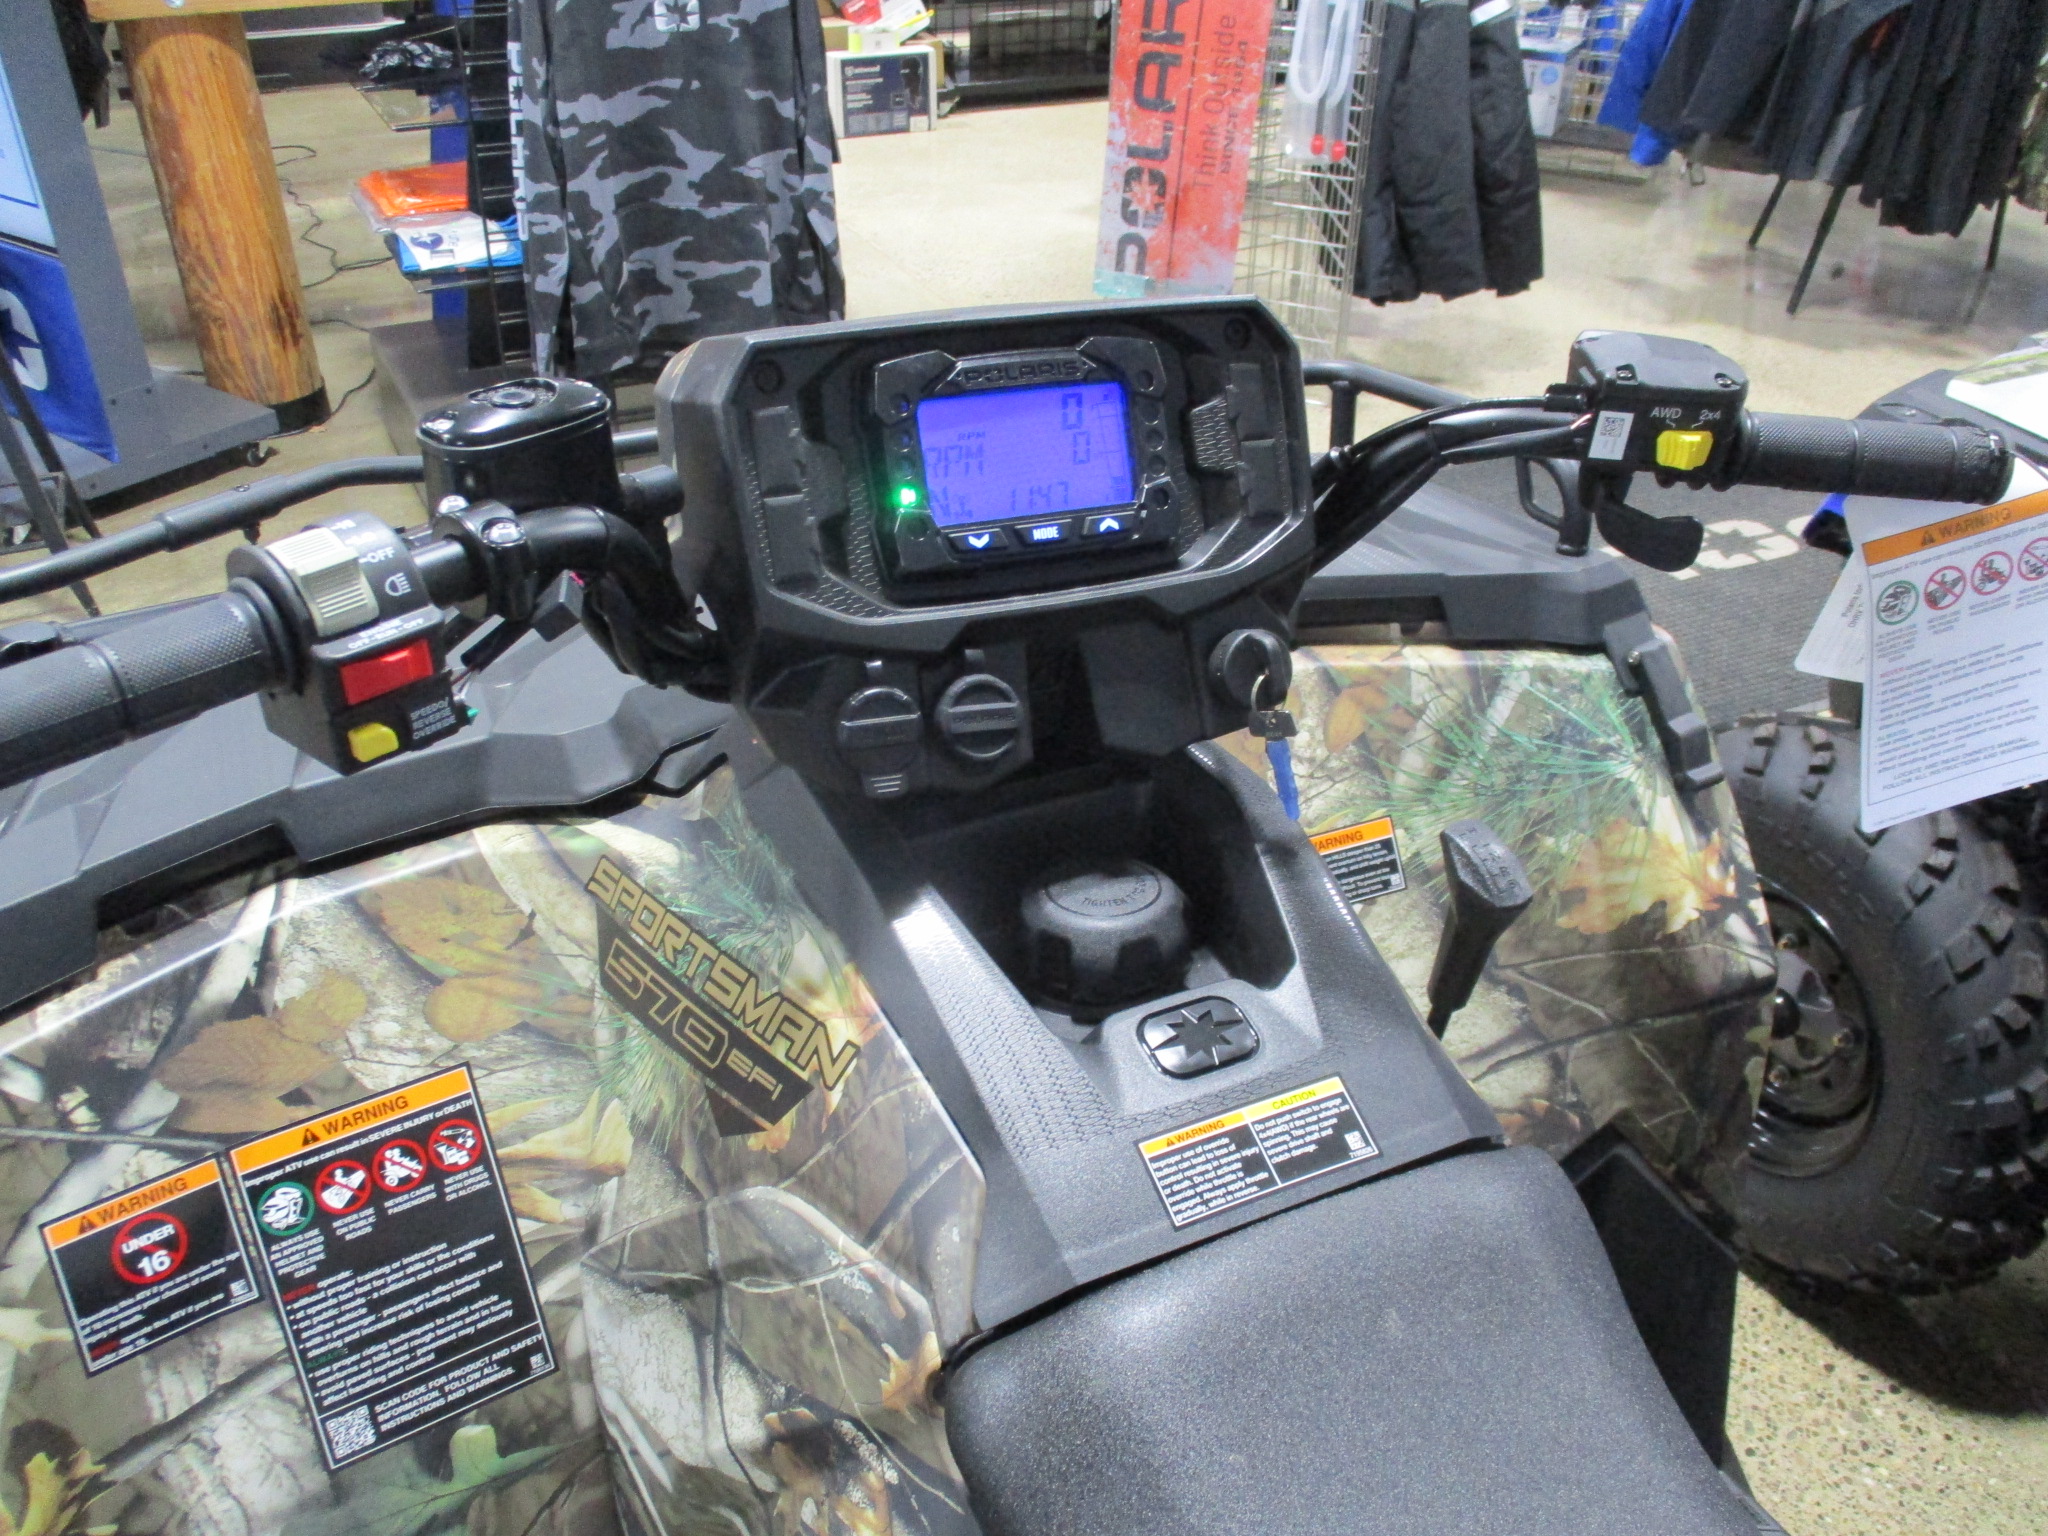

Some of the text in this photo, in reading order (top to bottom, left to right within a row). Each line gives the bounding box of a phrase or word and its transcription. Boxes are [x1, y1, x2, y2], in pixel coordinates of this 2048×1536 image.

[1193, 14, 1236, 188] Think Outside
[963, 361, 1081, 382] POLARIS
[1062, 393, 1082, 430] 0
[1650, 407, 1720, 420] AWD 2x4
[958, 432, 985, 441] RPM
[1073, 431, 1090, 464] 0
[1033, 526, 1059, 540] MODE
[1939, 508, 2011, 538] WARNING
[413, 708, 452, 730] REVERSE
[413, 716, 456, 740] OVERRIDE
[585, 855, 860, 1090] SPORTSMAN
[604, 938, 783, 1100] 570 EFI
[1271, 1088, 1316, 1109] CAUTION
[322, 1093, 409, 1136] WARNING
[284, 1160, 302, 1172] ATV
[367, 1123, 402, 1141] SEVERE
[402, 1112, 433, 1128] INJURY
[442, 1098, 473, 1114] DEATH
[1174, 1119, 1225, 1142] WARNING
[444, 1165, 483, 1184] NEVER USE
[444, 1172, 488, 1192] WITH DRUGS
[96, 1176, 188, 1224] WARNING
[384, 1184, 434, 1207] NEVER CARRY
[445, 1180, 491, 1201] OR ALCOHOL
[388, 1192, 436, 1214] PASSENGERS
[332, 1207, 374, 1227] NEVER USE
[336, 1215, 375, 1235] ON PUBLIC
[120, 1222, 175, 1255] UNDER
[303, 1228, 319, 1238] USE
[345, 1225, 371, 1240] ROADS
[282, 1236, 323, 1255] APPROVED
[307, 1244, 323, 1255] AND
[135, 1247, 173, 1279] 16
[294, 1264, 316, 1277] GEAR
[374, 1332, 544, 1412] SCAN CODE FOR PRODUCT AND SAFETY
[444, 1370, 481, 1391] FOLLOW
[483, 1363, 499, 1375] ALL
[380, 1397, 445, 1430] INSTRUCTIONS
[447, 1388, 466, 1401] AND
[466, 1367, 514, 1392] WARNINGS.
